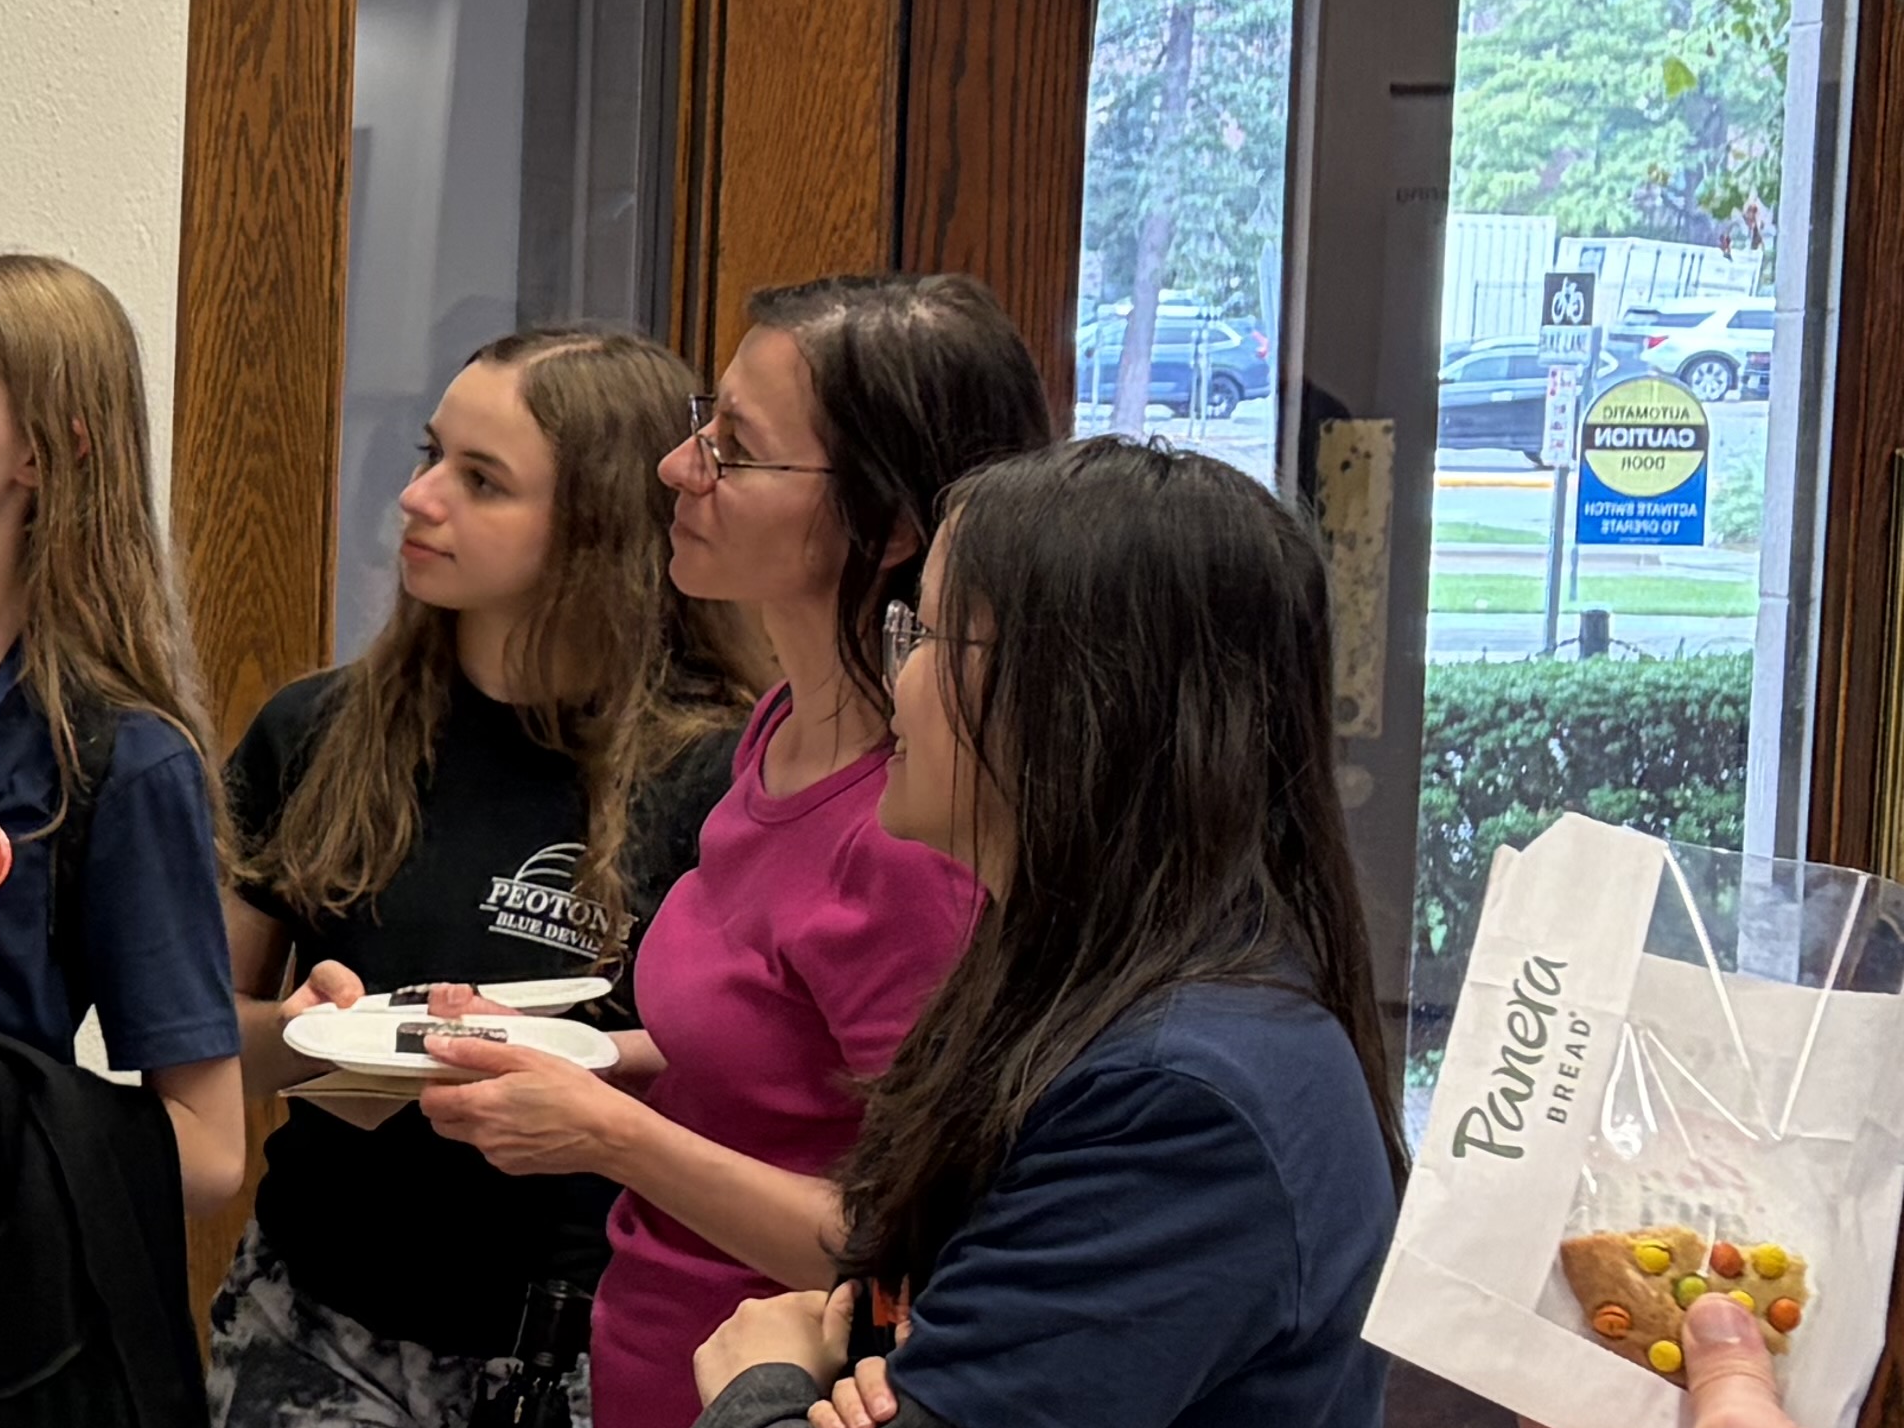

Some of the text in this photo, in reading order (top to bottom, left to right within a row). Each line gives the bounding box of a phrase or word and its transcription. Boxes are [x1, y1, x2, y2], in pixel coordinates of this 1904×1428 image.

[495, 911, 542, 934] BLUE
[1452, 956, 1569, 1160] Panera
[1546, 1018, 1593, 1125] BREAD
